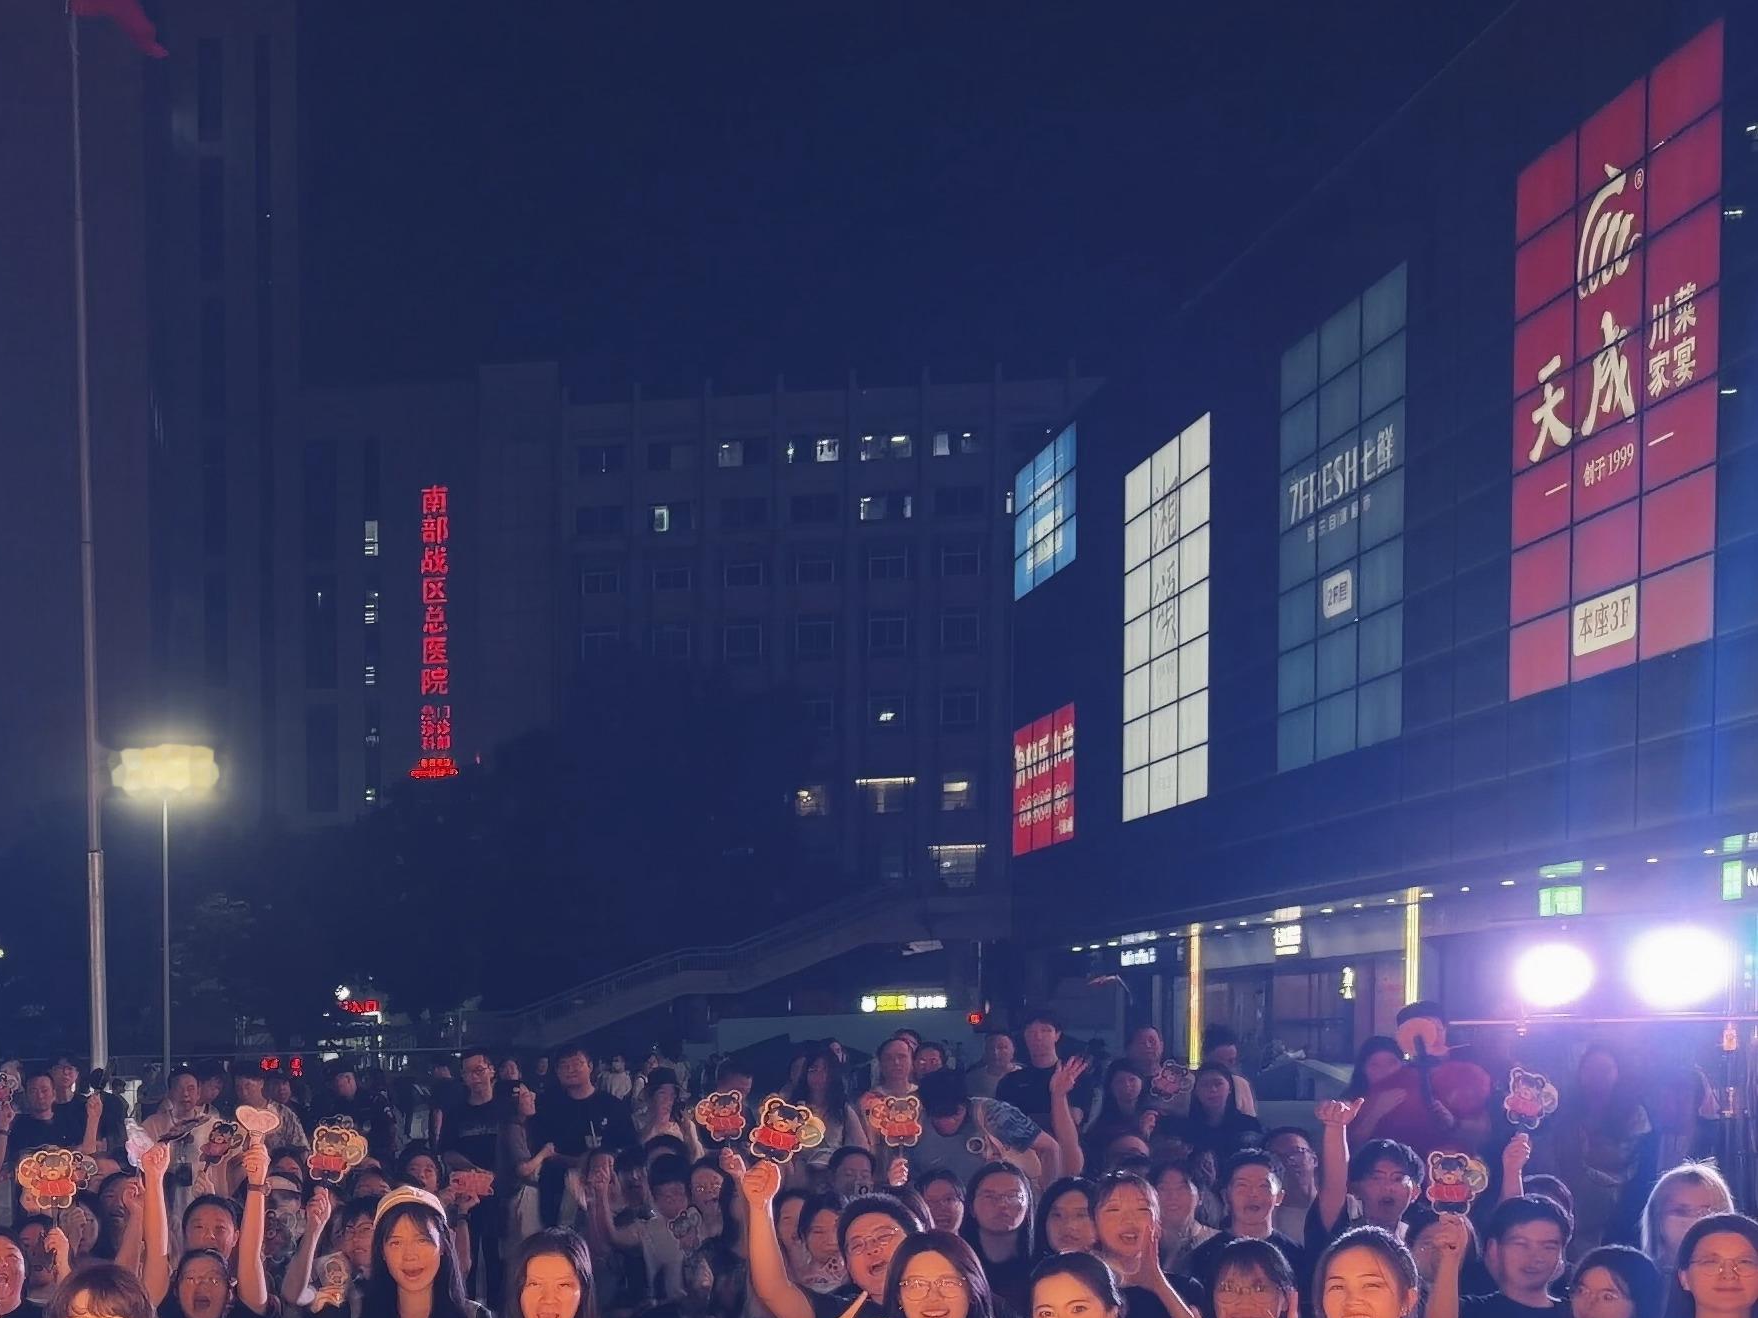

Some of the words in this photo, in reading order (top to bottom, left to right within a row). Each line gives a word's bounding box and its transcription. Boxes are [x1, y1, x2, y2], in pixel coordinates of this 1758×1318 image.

[1650, 281, 1697, 347] 川菜
[1528, 311, 1635, 463] 天成
[1647, 335, 1697, 398] 家宴
[1288, 446, 1359, 525] 7FRESH
[1361, 424, 1394, 483] 七鲜
[420, 484, 449, 696] 南部战区总医院
[1578, 597, 1632, 643] 本座3F
